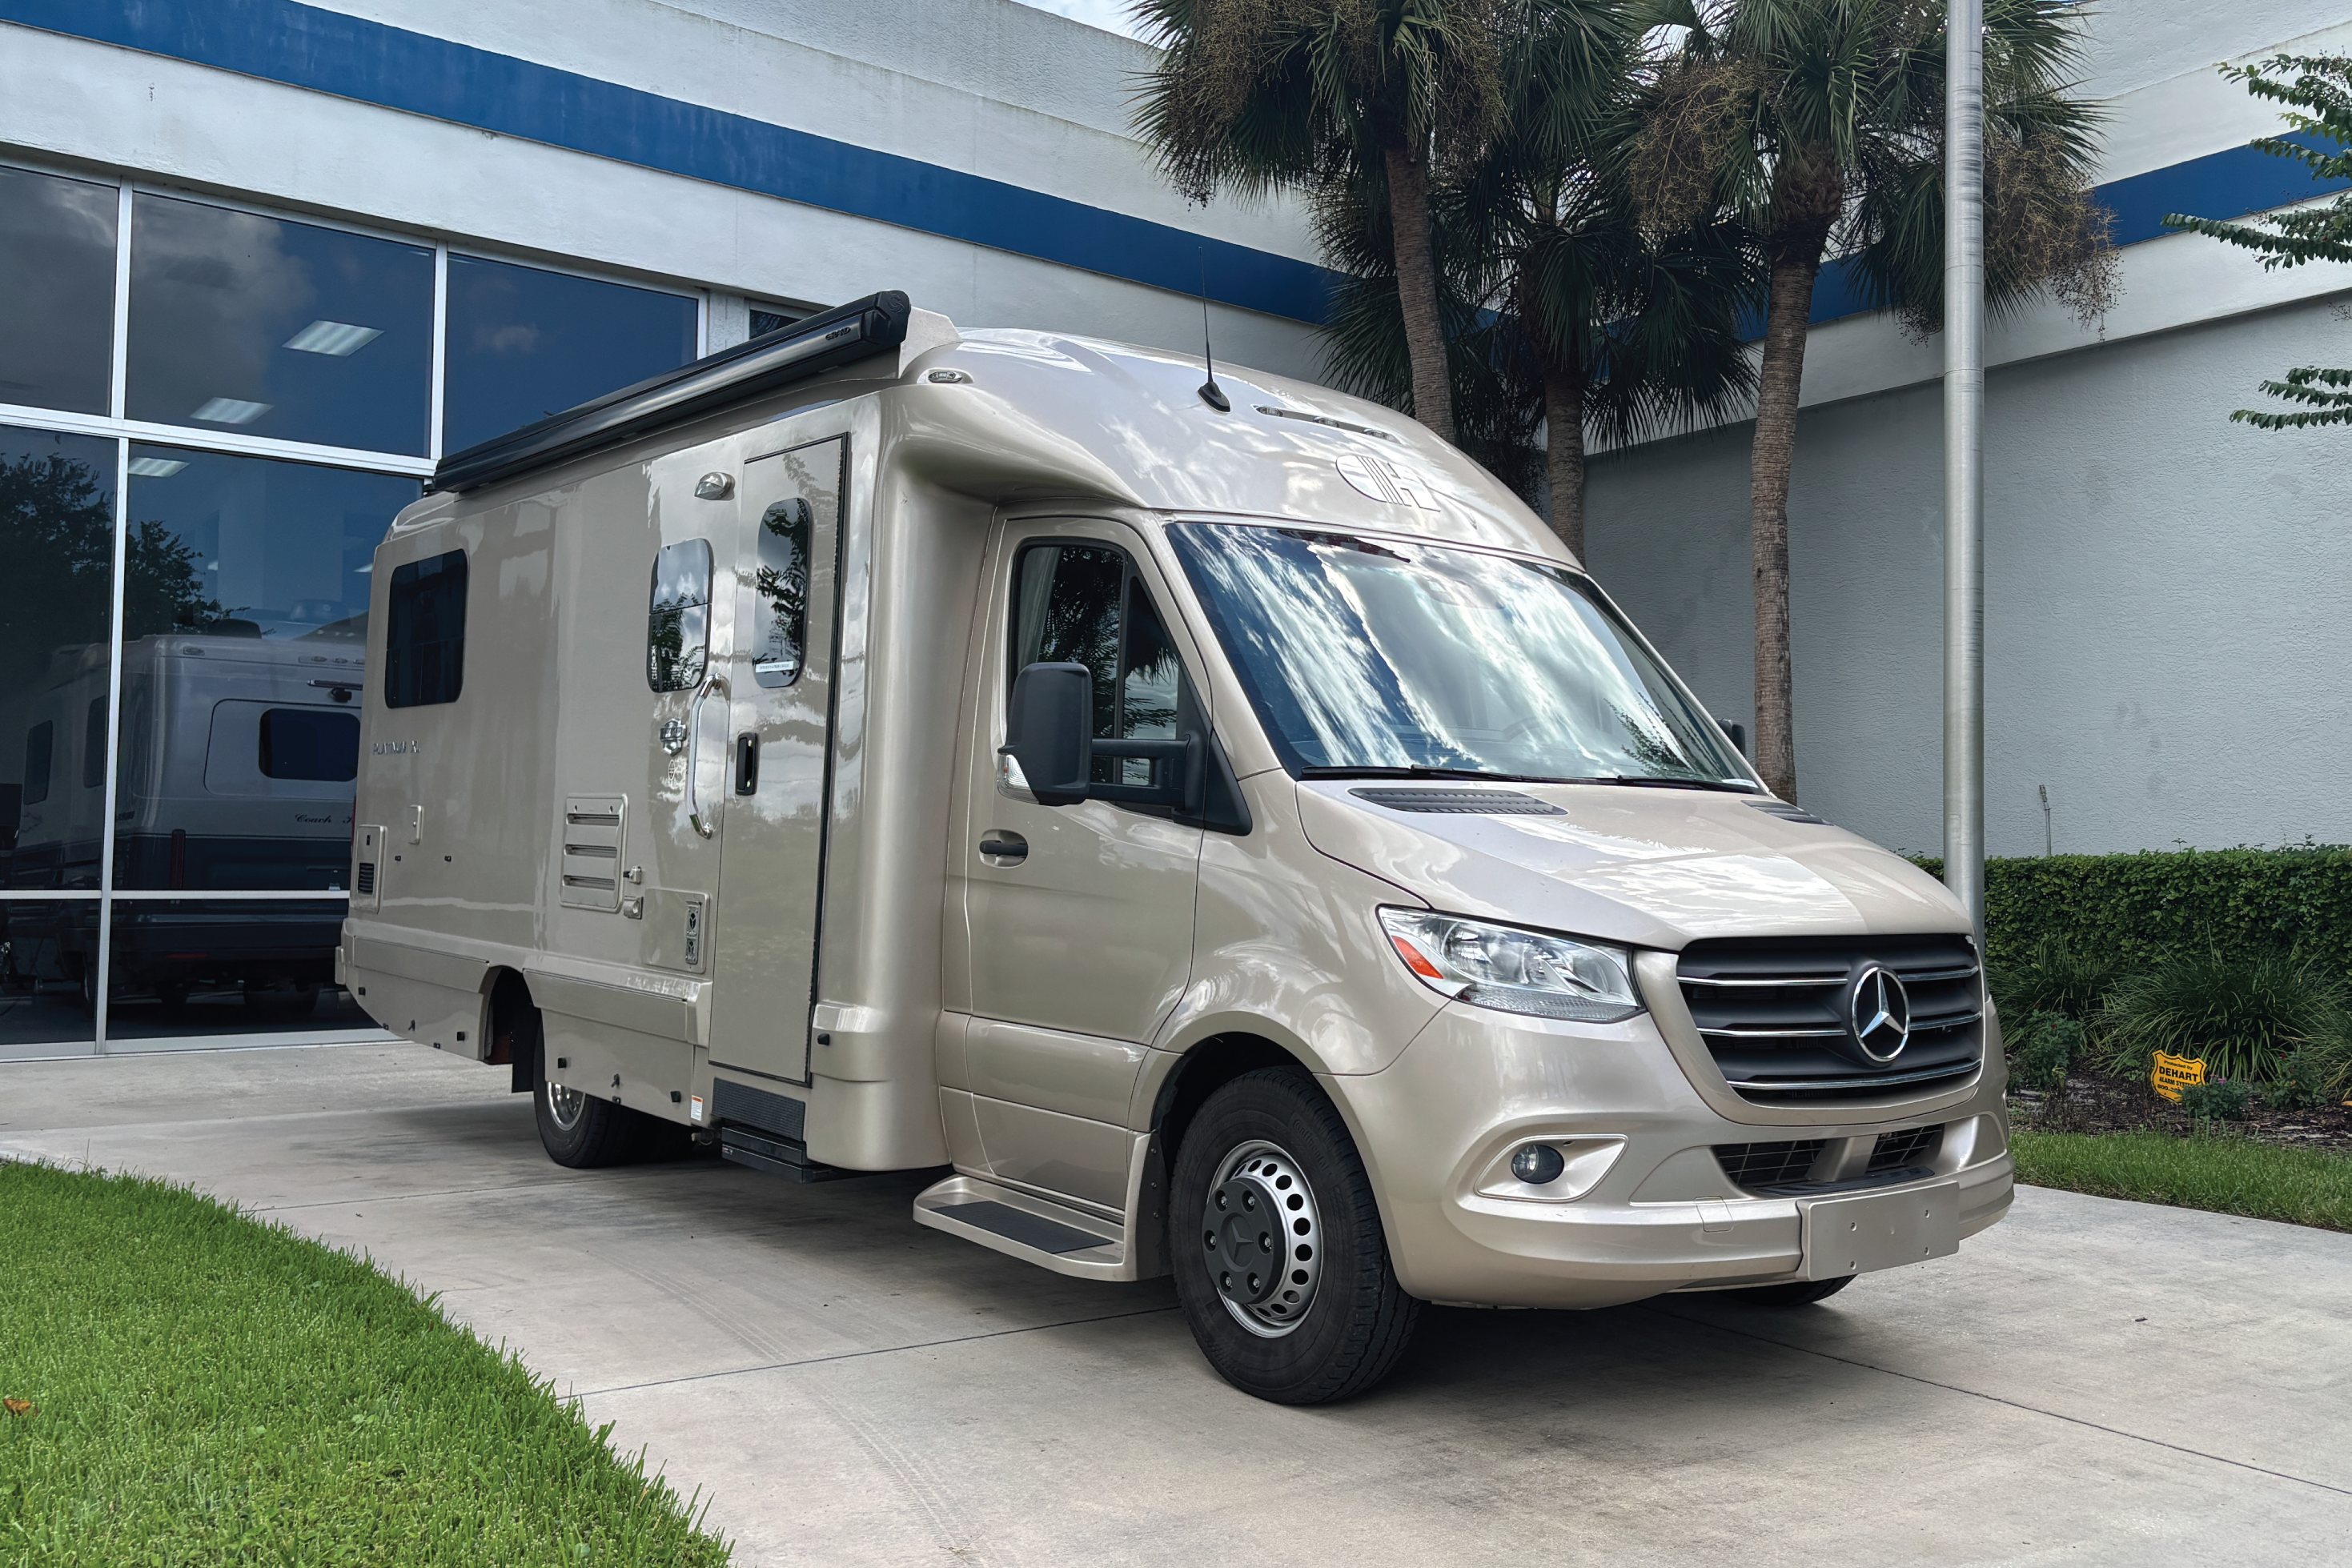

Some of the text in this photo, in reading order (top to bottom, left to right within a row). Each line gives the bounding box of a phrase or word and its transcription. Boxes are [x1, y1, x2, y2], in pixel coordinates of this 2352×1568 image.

[295, 813, 332, 824] Coach
[2159, 1066, 2198, 1081] DEHART
[2159, 1077, 2175, 1085] ALARM
[1293, 1119, 1329, 1171] Continental
